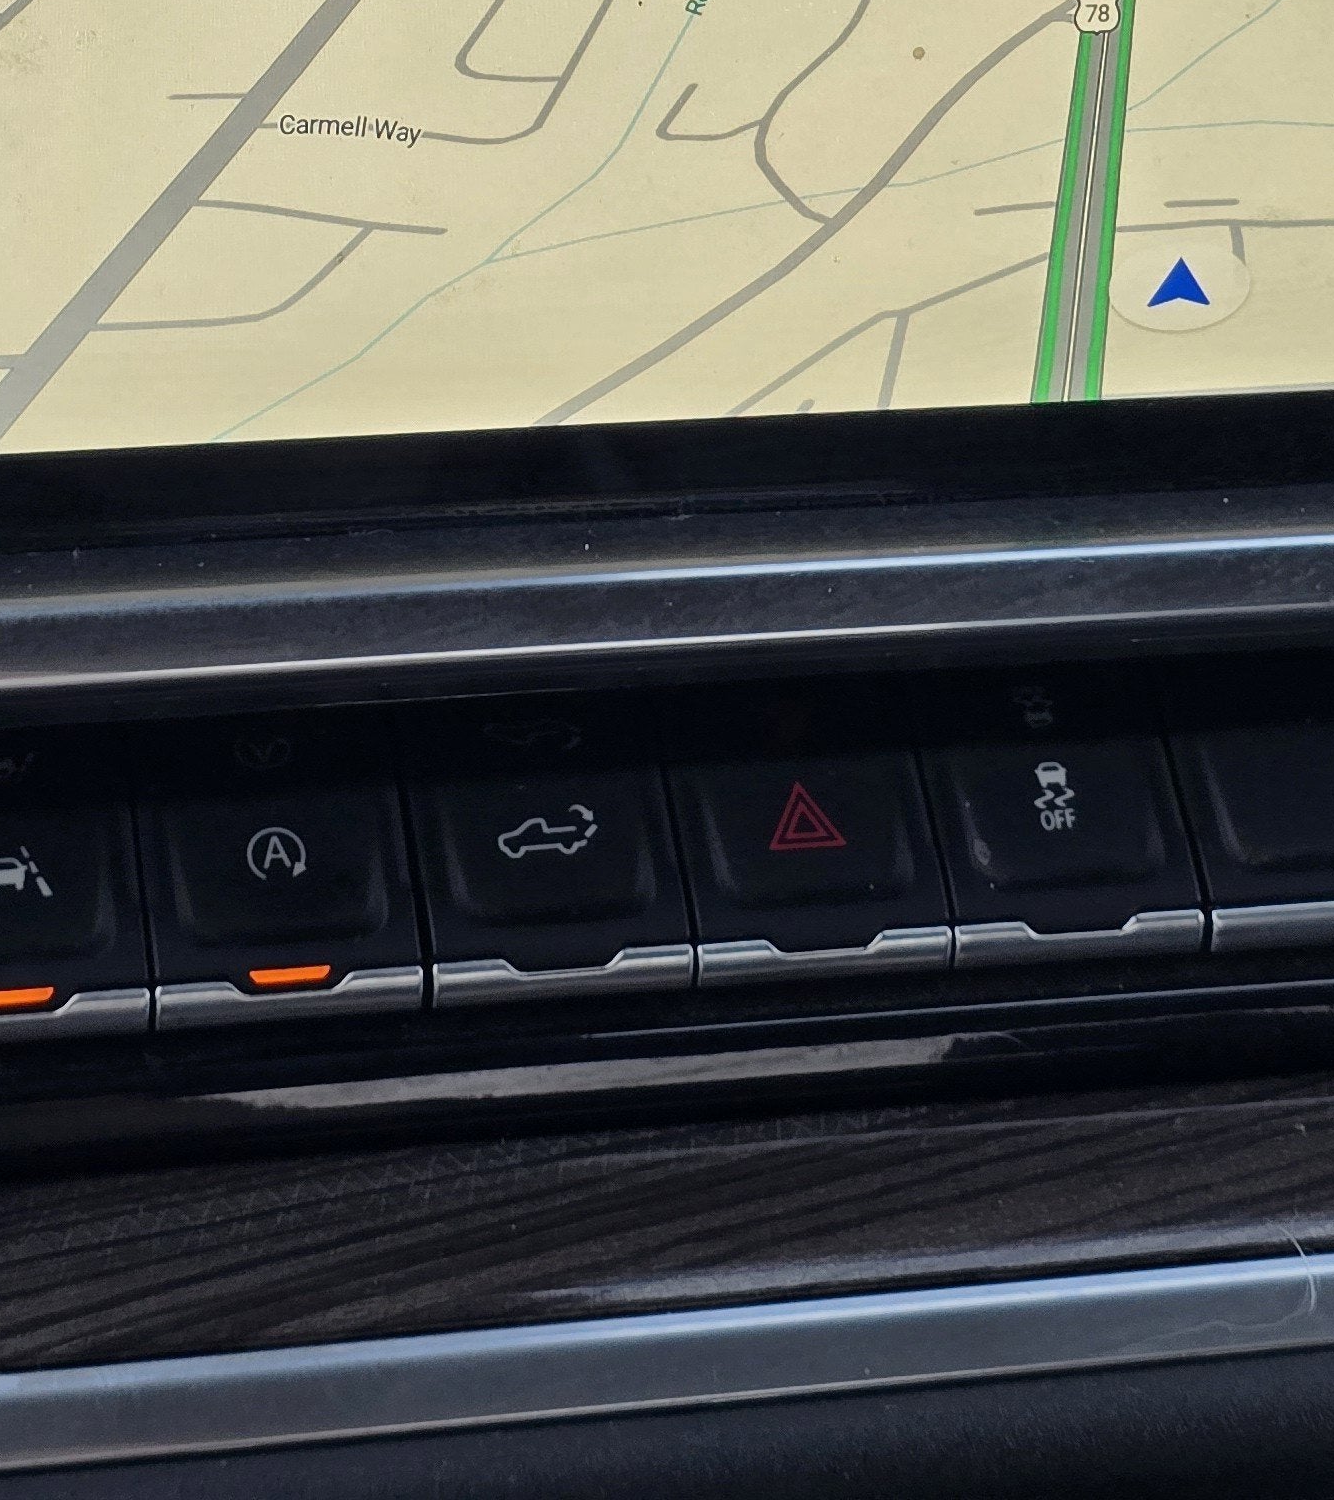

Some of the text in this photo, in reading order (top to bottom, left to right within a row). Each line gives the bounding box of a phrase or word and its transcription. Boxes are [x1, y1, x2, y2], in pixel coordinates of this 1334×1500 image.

[1085, 3, 1110, 24] 78
[279, 114, 422, 148] Carmell Way
[1040, 807, 1075, 831] OFF
